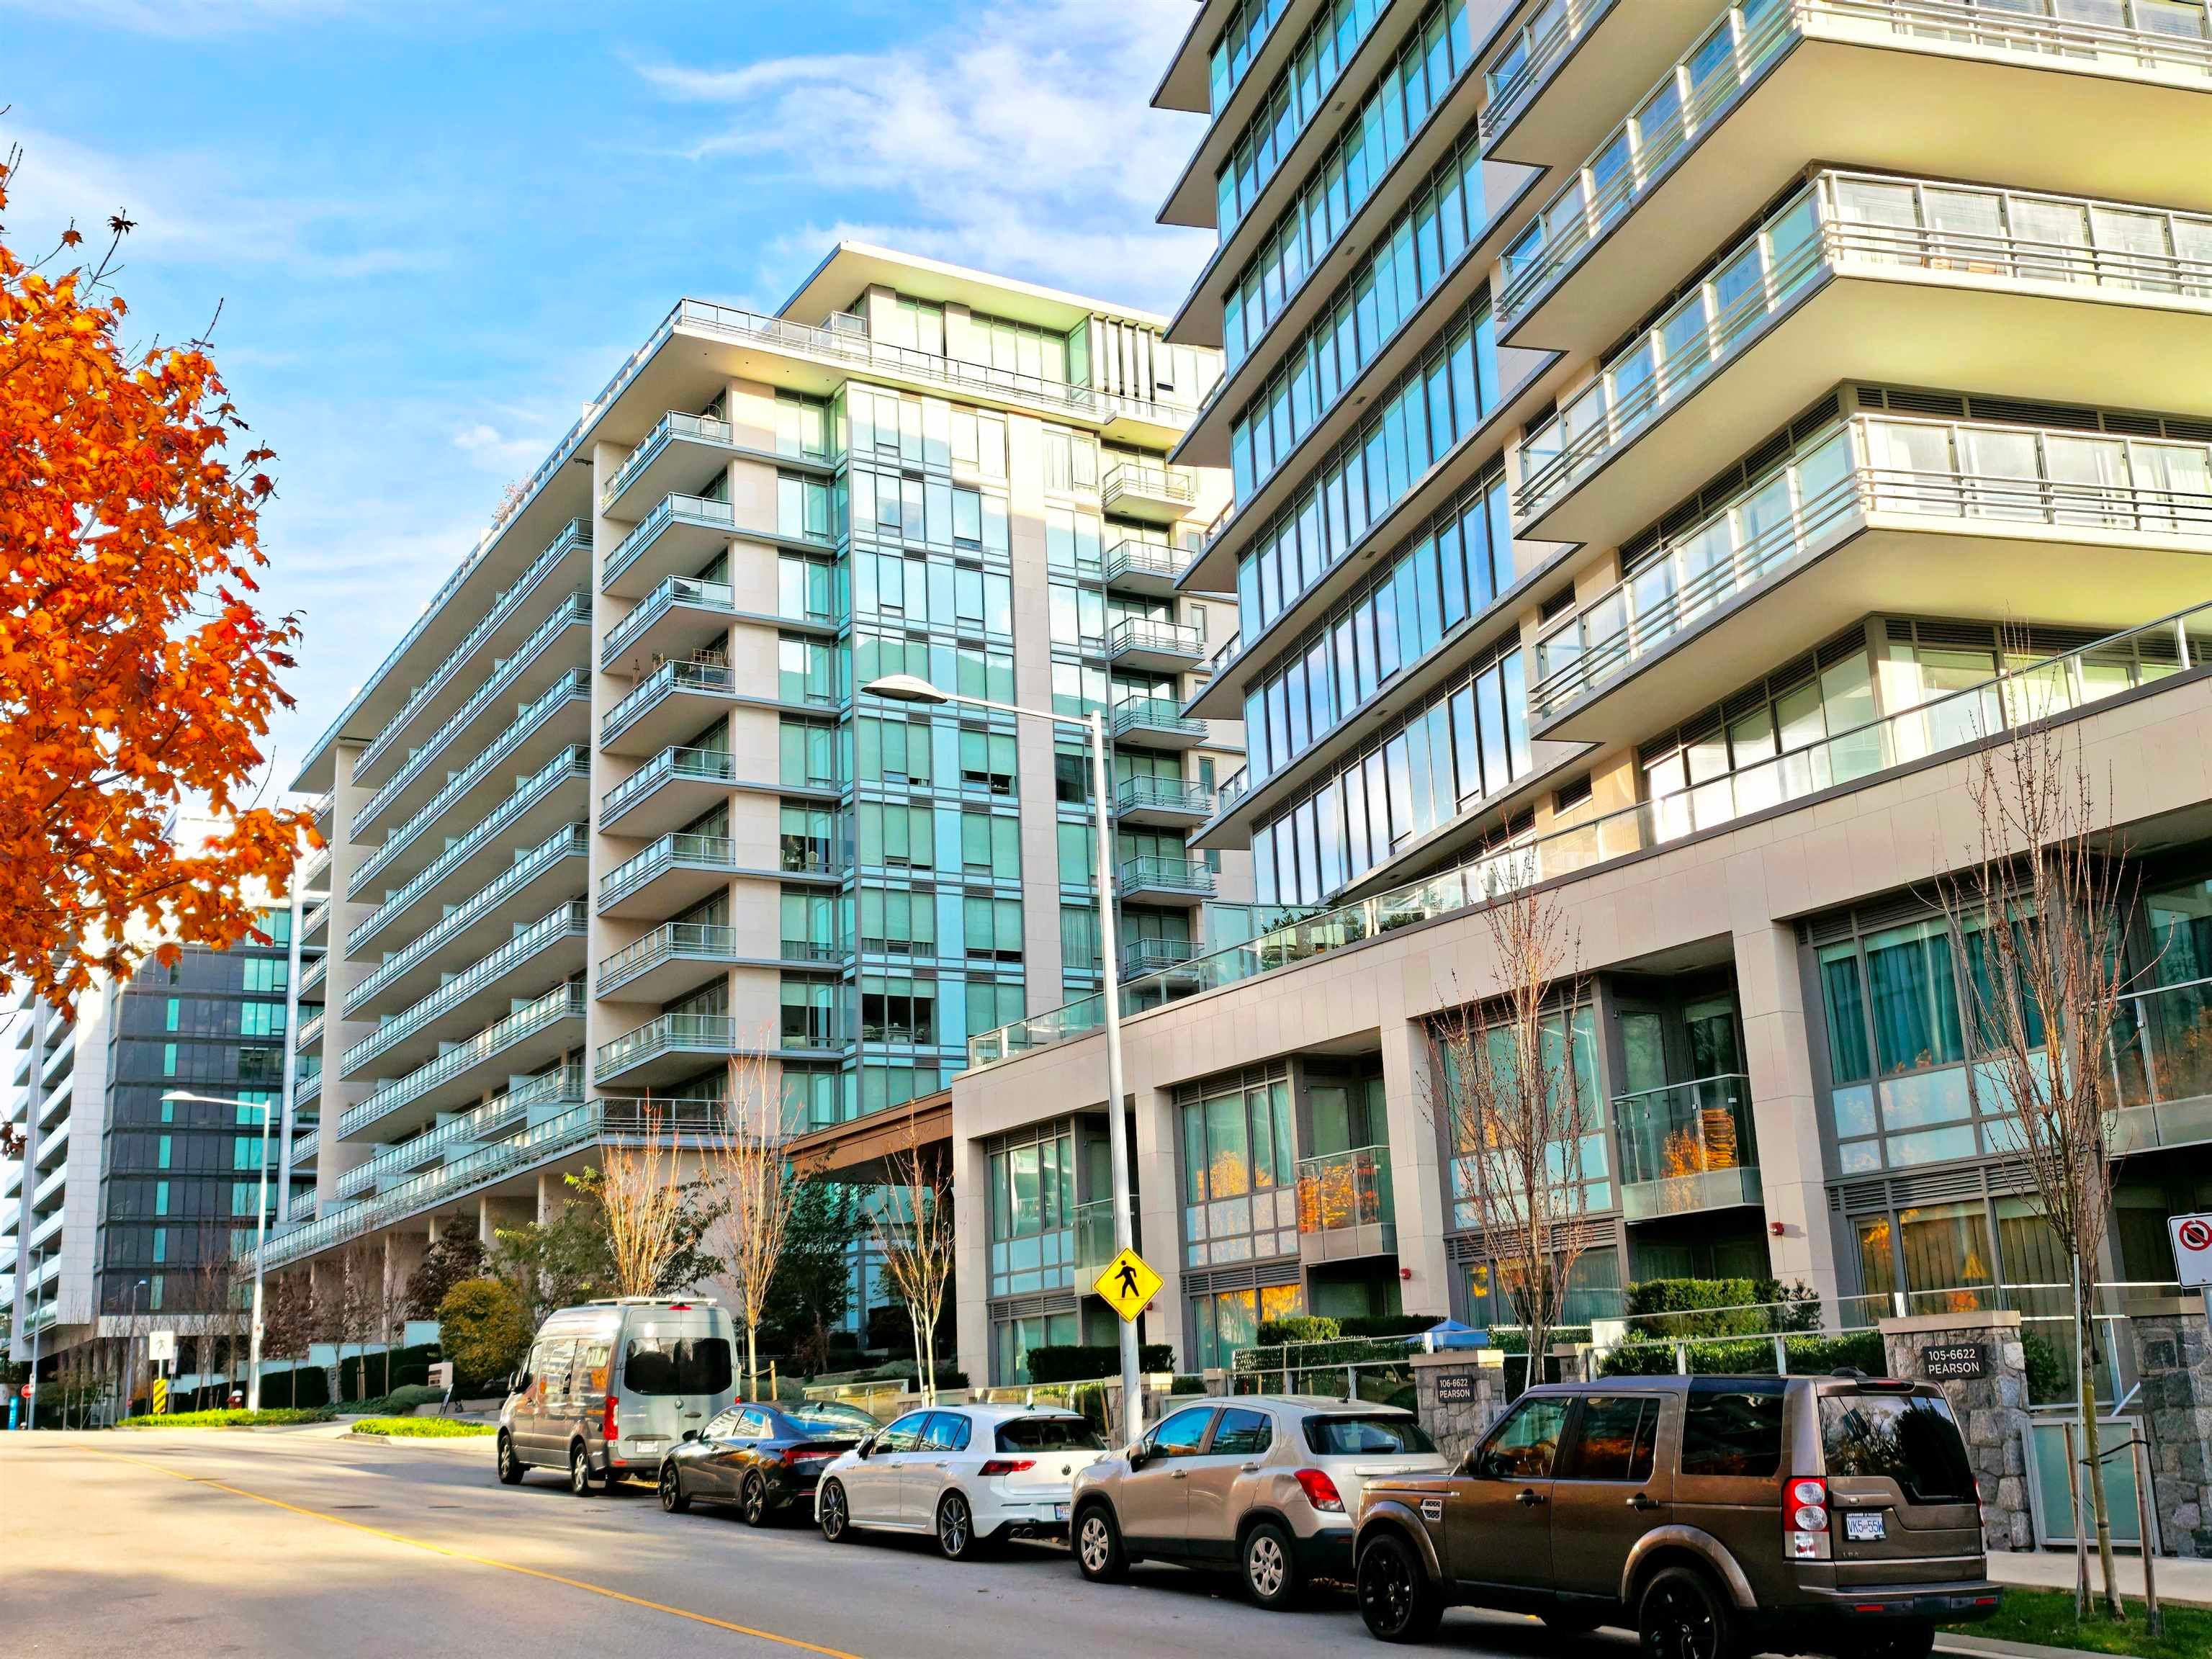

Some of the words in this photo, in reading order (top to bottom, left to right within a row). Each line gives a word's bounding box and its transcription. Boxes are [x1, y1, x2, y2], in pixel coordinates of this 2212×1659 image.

[1928, 1349, 1976, 1361] 105-6622
[1928, 1362, 1979, 1375] PEARSON
[1439, 1378, 1468, 1388] 106-6622
[1439, 1389, 1470, 1399] PEARSON
